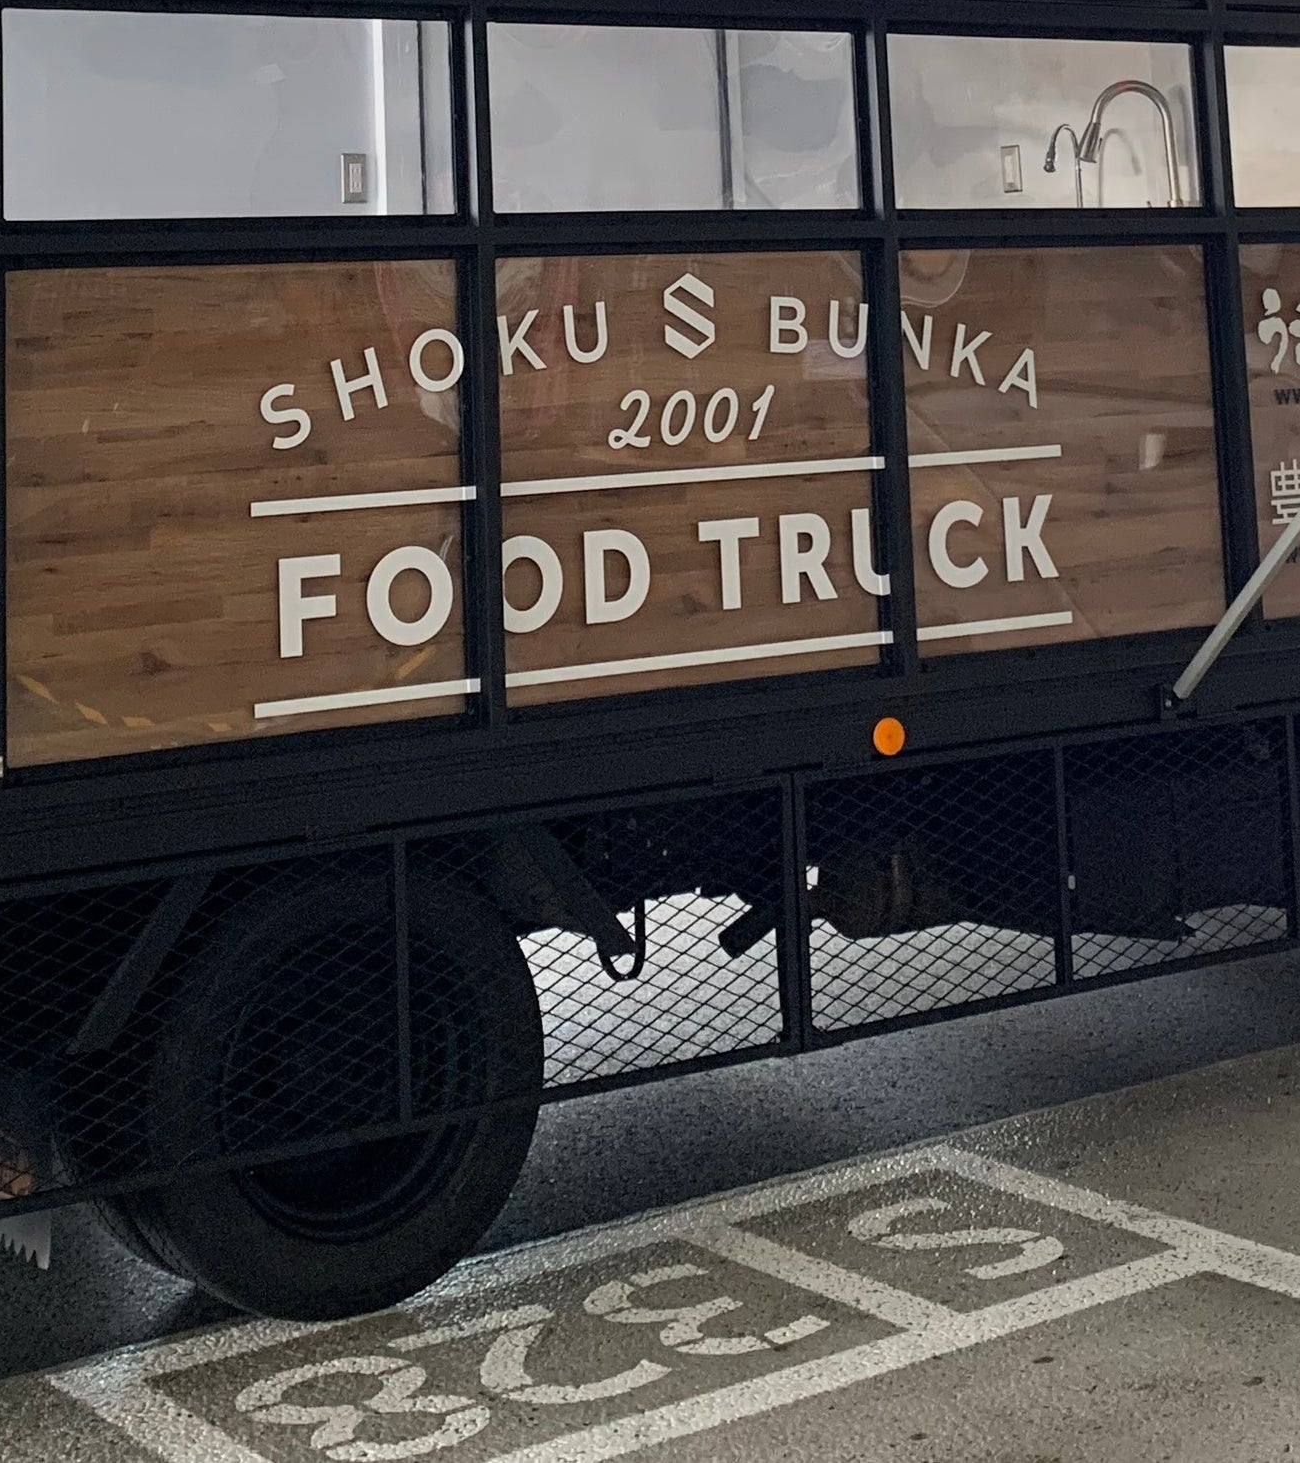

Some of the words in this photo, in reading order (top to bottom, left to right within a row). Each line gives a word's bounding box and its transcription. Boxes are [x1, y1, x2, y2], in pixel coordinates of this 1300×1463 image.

[259, 300, 611, 451] SHOKU
[769, 295, 1041, 410] BUNKA
[607, 383, 778, 451] 2001
[278, 528, 652, 659] FOOD
[698, 494, 1061, 612] TRUCK
[845, 1196, 1064, 1282] S
[235, 1262, 832, 1462] 328
